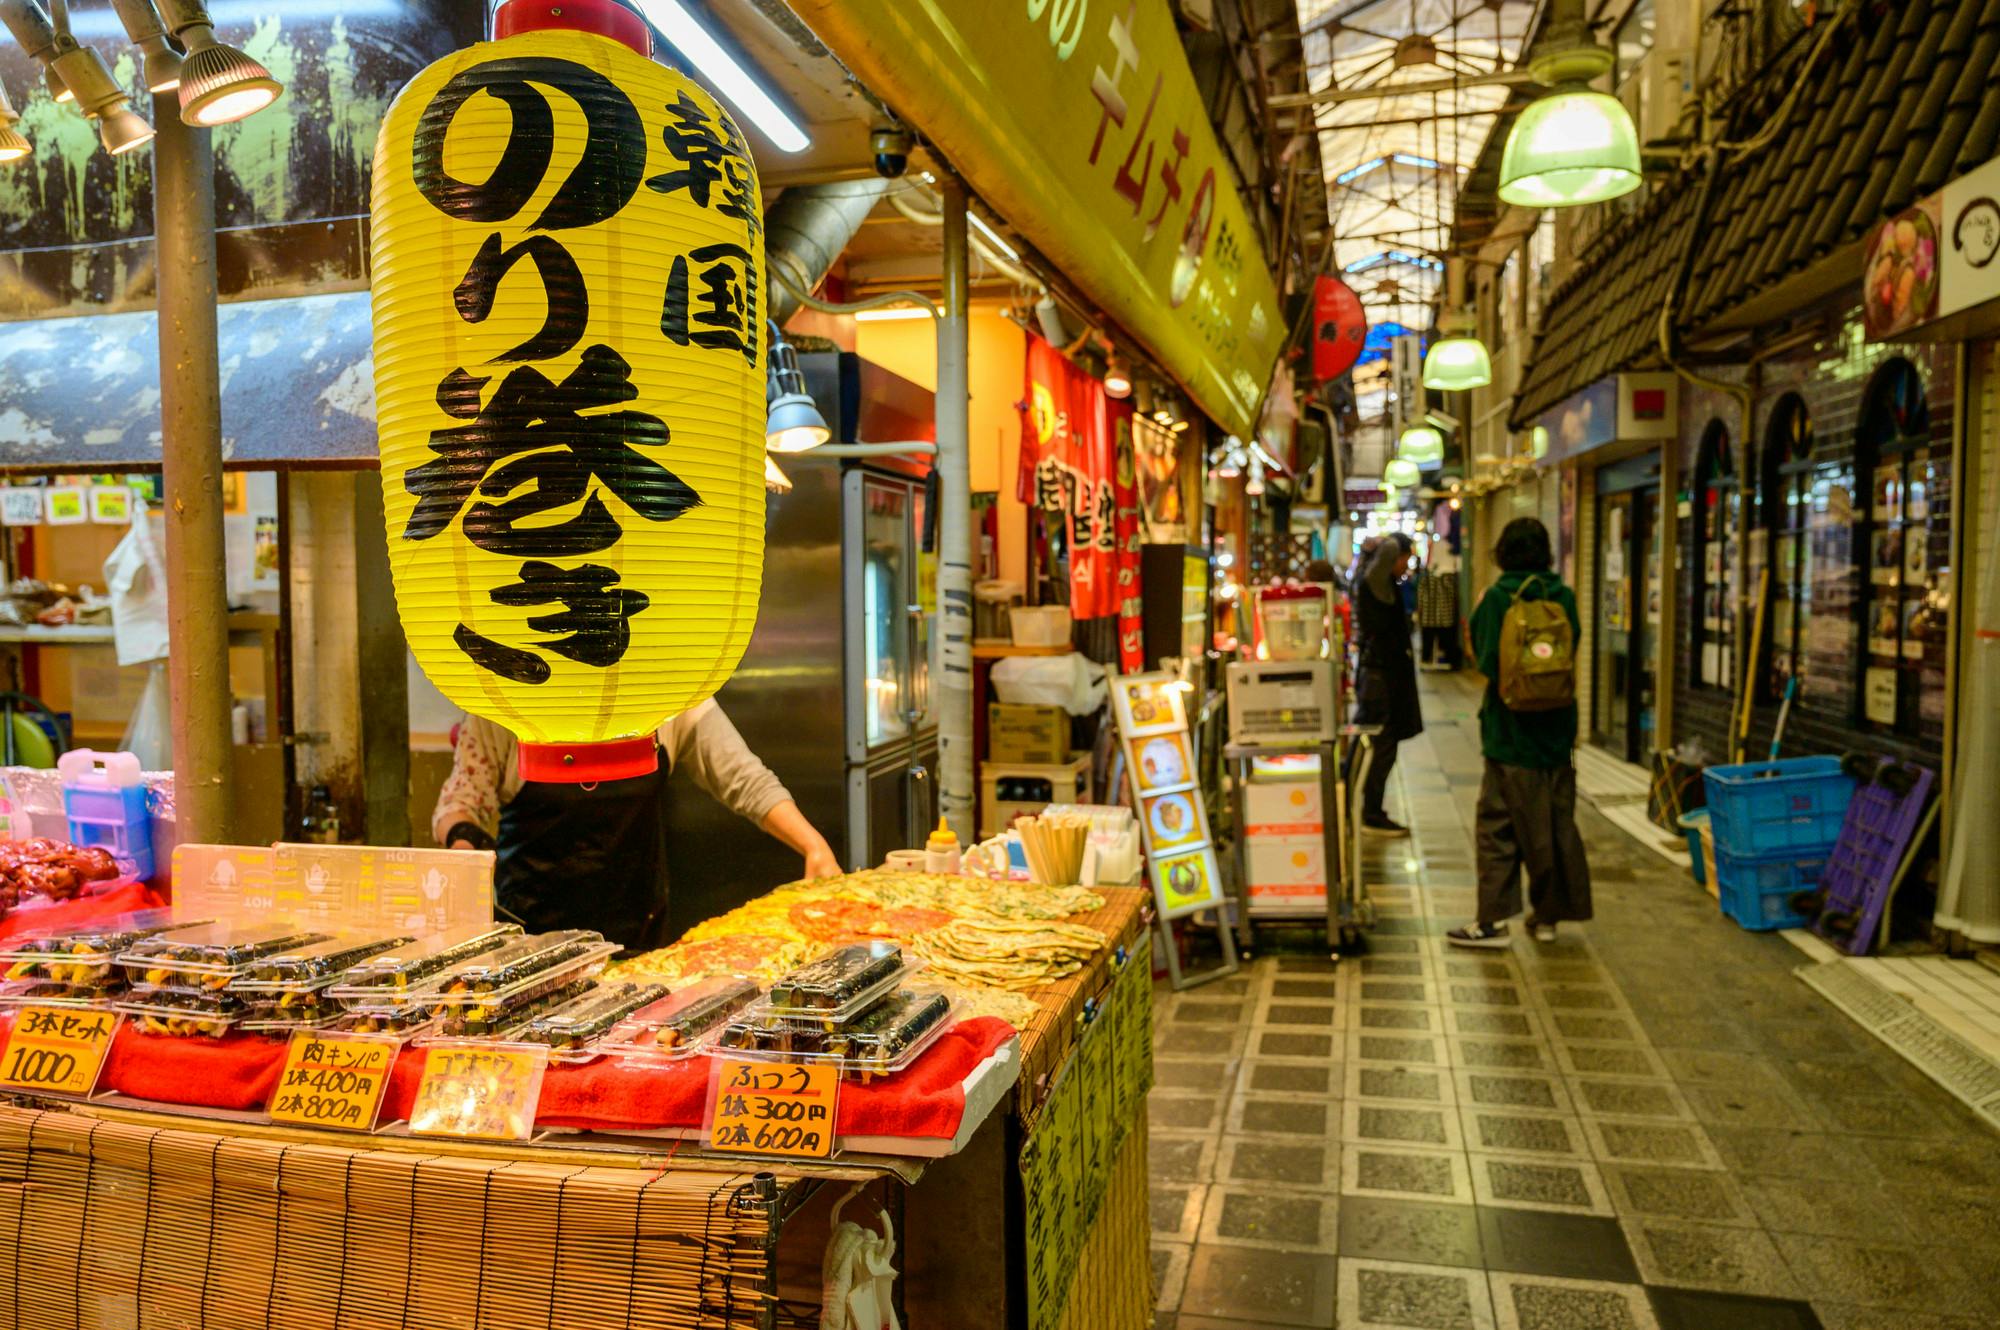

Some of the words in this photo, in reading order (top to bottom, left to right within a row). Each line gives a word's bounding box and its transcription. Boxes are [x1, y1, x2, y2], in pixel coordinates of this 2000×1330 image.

[645, 89, 763, 369] 韓国
[402, 56, 705, 685] のり巻き
[21, 1012, 108, 1042] 3本セット
[5, 1047, 85, 1087] 1000円
[302, 1039, 380, 1069] 肉キンパ
[730, 1065, 811, 1095] ふつう
